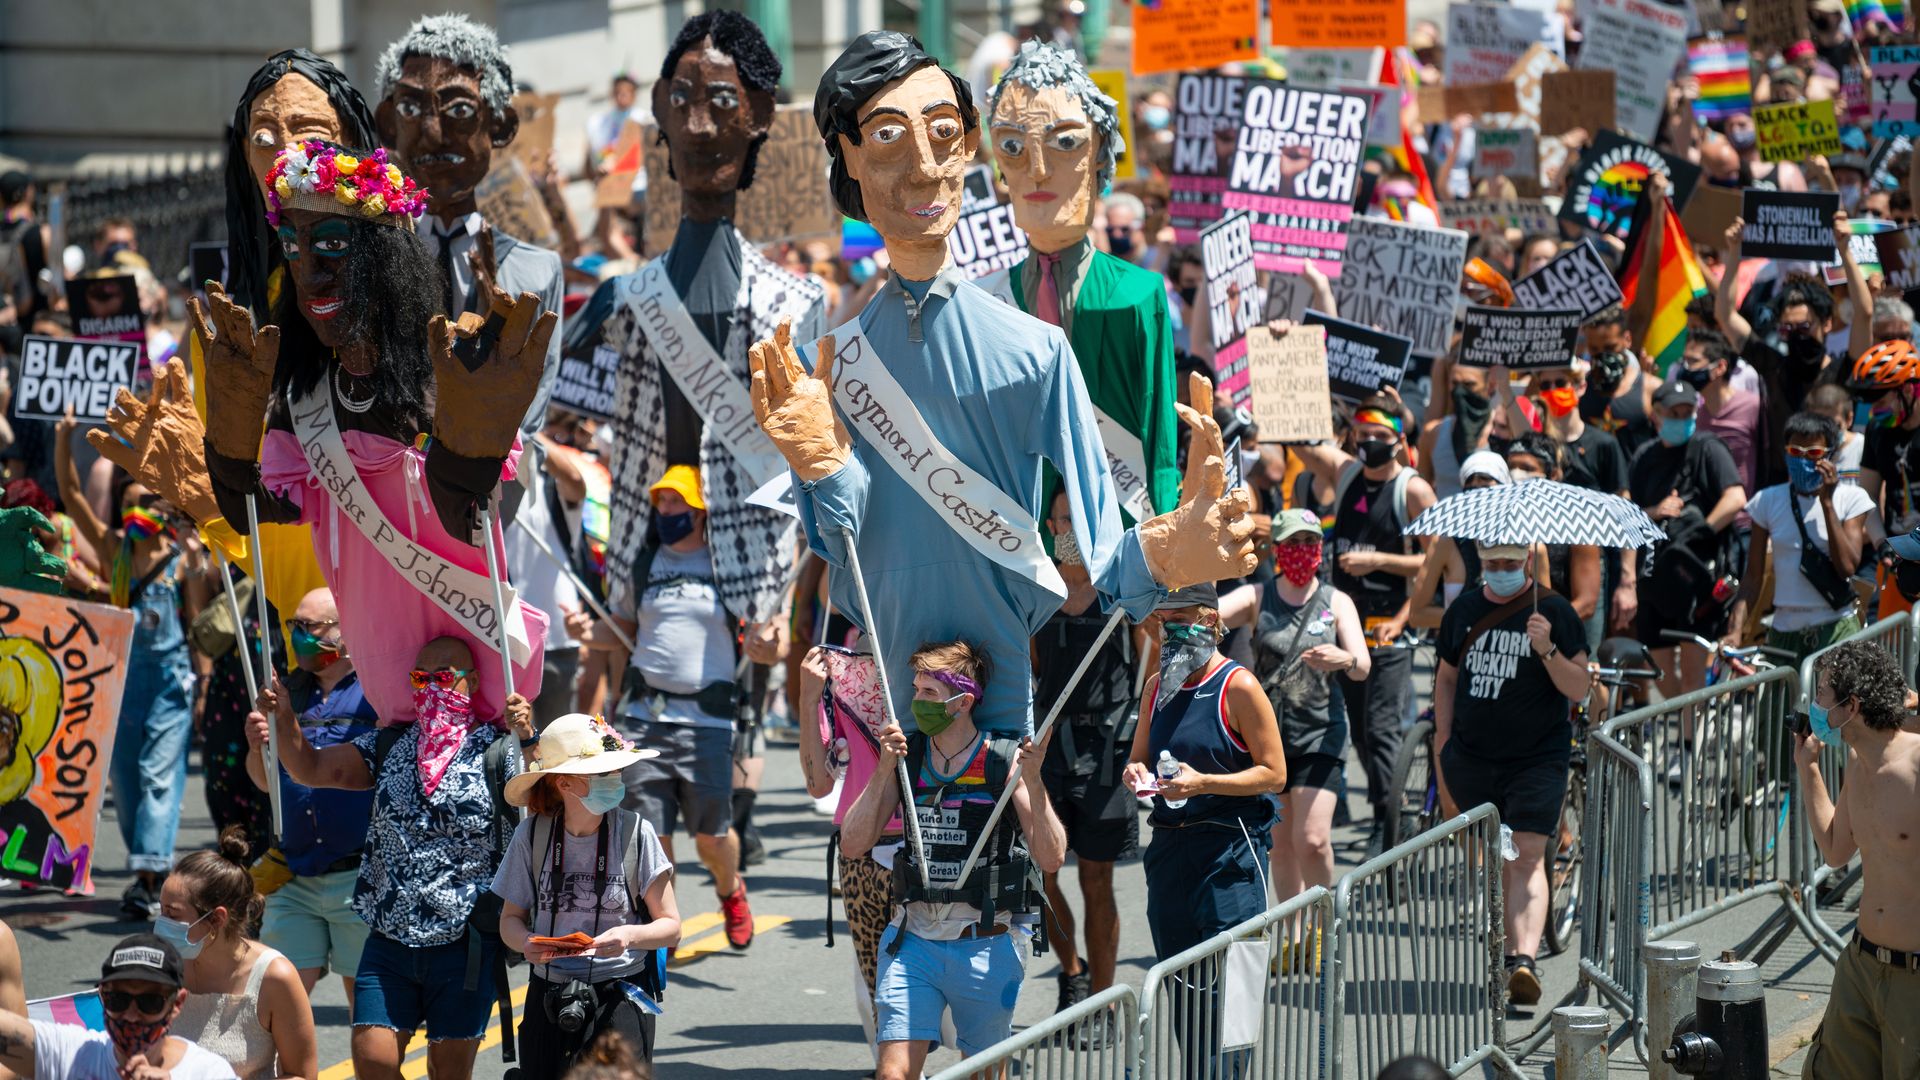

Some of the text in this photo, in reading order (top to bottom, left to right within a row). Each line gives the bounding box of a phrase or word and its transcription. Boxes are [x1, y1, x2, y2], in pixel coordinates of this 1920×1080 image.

[1179, 75, 1242, 118] QUE
[1243, 84, 1367, 139] QUEER
[1756, 105, 1809, 124] BLACK
[1237, 126, 1362, 165] LIBERATION
[1583, 144, 1632, 184] BLACK
[1224, 207, 1259, 224] AD
[1266, 212, 1341, 233] AGAINST
[1306, 205, 1342, 217] LIVES
[1757, 205, 1822, 225] STONEWALL
[949, 203, 1028, 264] UEE
[1202, 214, 1254, 281] QUEER
[1351, 220, 1462, 250] LIVES MATTER
[1744, 224, 1836, 246] WAS A REBELLION
[1395, 243, 1462, 283] TRANS
[1364, 272, 1453, 309] MATTER
[1514, 246, 1600, 310] BLACK
[1543, 272, 1620, 319] WER
[79, 313, 141, 336] DISARM
[1399, 305, 1453, 351] MATTER
[1466, 311, 1581, 329] WE WHO BELIEVE
[1480, 327, 1563, 341] IN FREEDOM
[629, 268, 686, 363] Simon
[683, 358, 758, 445] Nkoli
[1328, 334, 1380, 362] WE MUST
[1464, 349, 1570, 365] UNTIL IT COMES
[1472, 337, 1567, 352] CANNOT REST
[24, 340, 132, 384] BLACK
[560, 357, 601, 389] WILL
[592, 345, 620, 373] WE
[1252, 350, 1323, 368] ANYWHERE
[1349, 355, 1403, 382] SUPPORT
[1253, 375, 1328, 393] RESPONSIBLE
[1341, 366, 1382, 390] OTHER
[1257, 400, 1322, 415] QUEER PEOPLE
[832, 335, 1022, 552] Raymond Castro
[294, 399, 366, 525] Marsha
[372, 520, 395, 544] P
[1489, 629, 1531, 658] YORK
[1465, 650, 1519, 680] FUCKIN
[1469, 674, 1506, 700] CITY
[917, 811, 957, 825] Kind to
[921, 829, 966, 842] Another
[929, 864, 959, 877] Great
